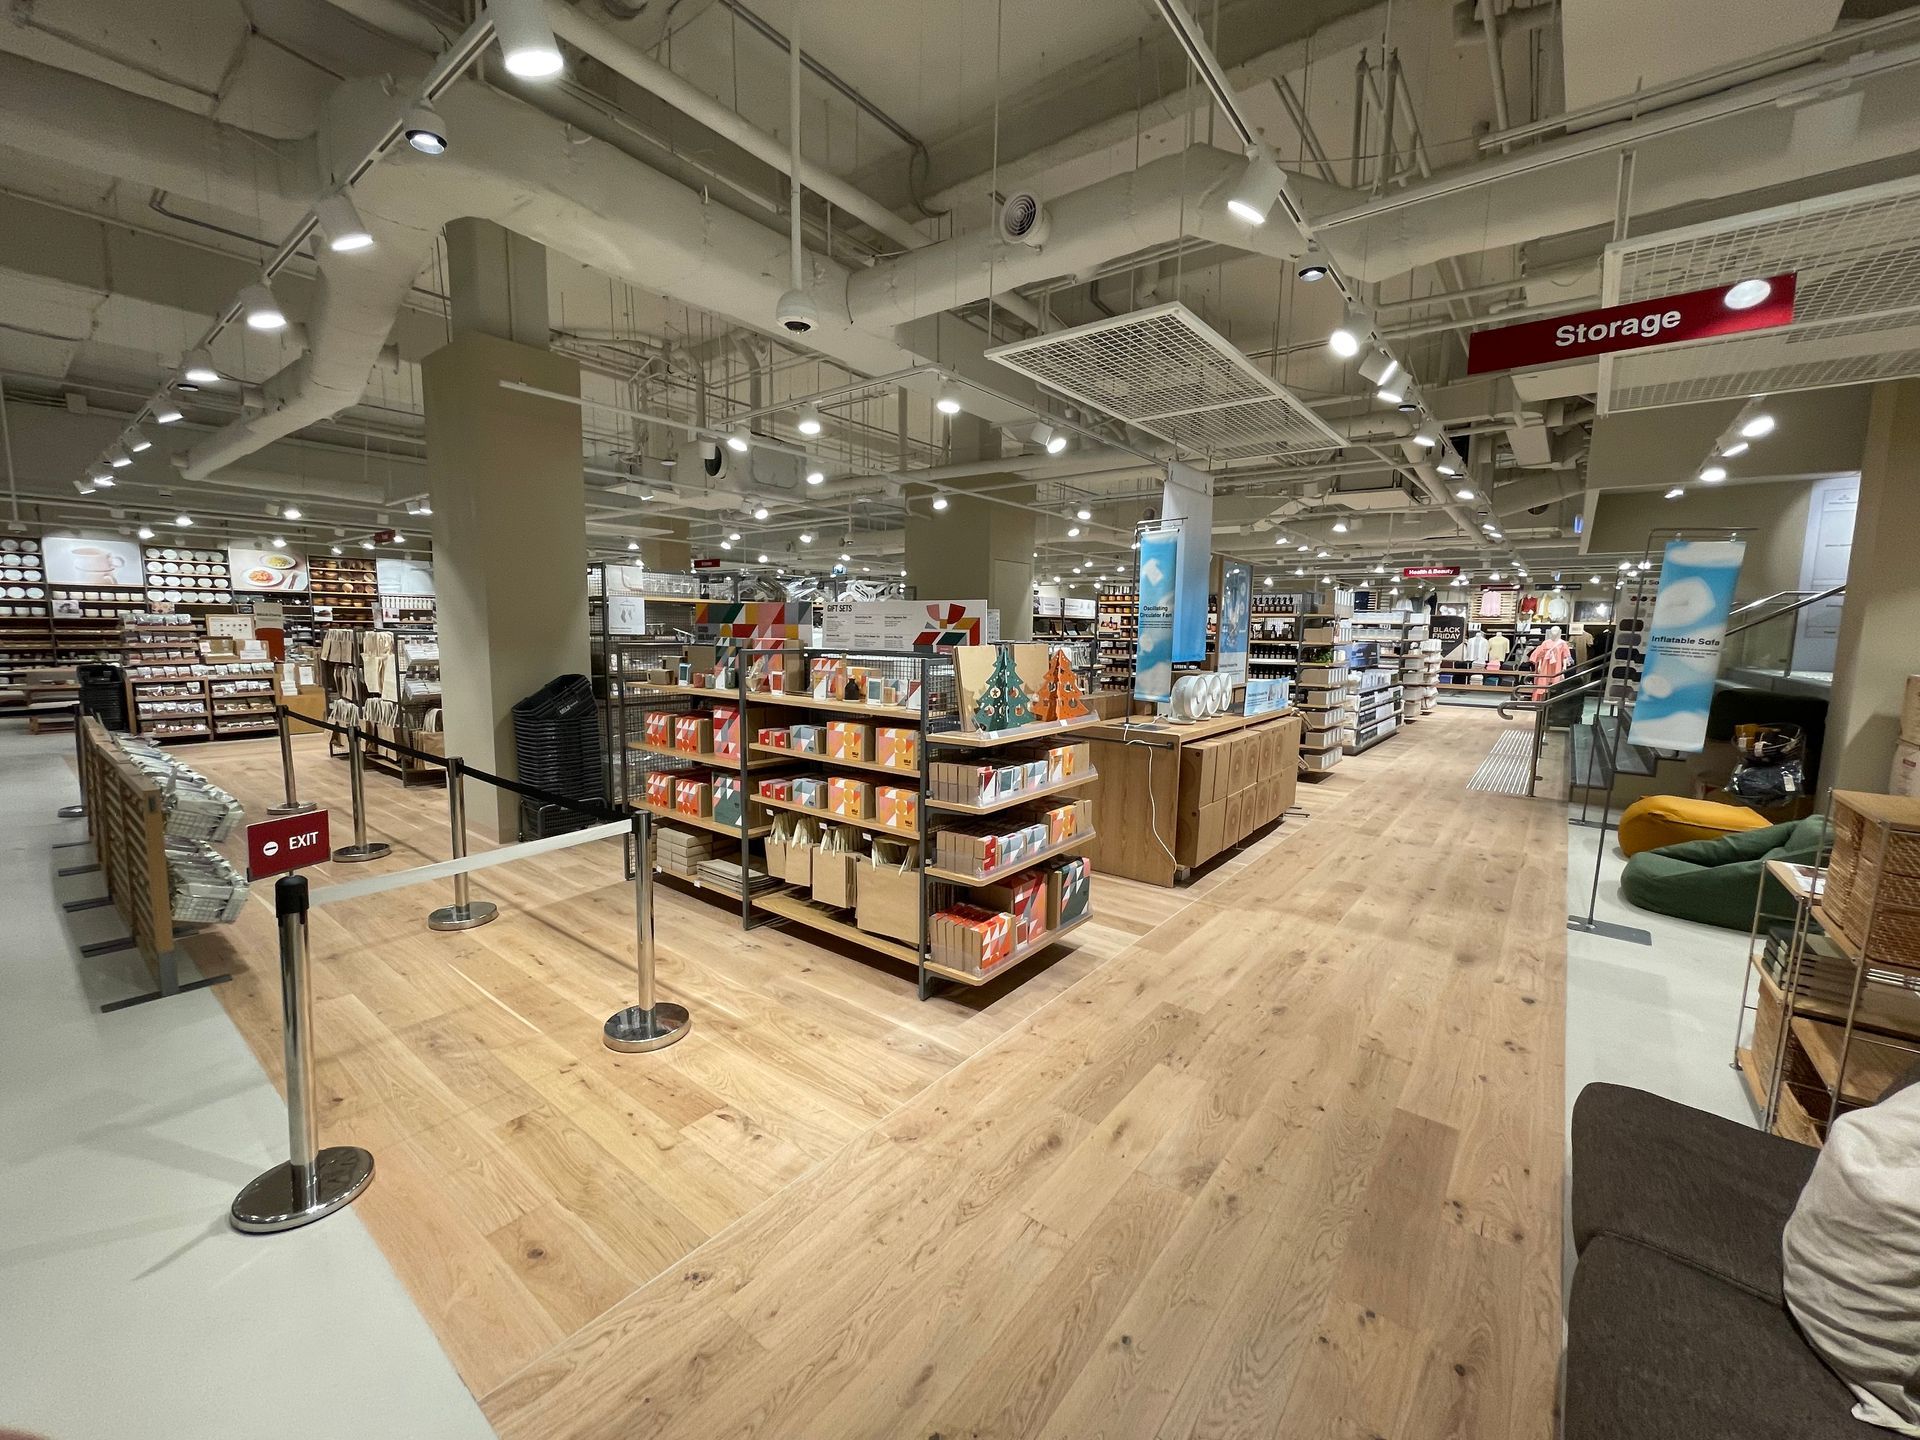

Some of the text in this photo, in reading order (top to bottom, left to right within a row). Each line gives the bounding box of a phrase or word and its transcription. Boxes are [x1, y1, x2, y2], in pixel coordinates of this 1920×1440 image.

[1555, 310, 1682, 347] Storage
[1651, 635, 1720, 646] Inflatable Sofa
[289, 832, 318, 850] EXIT
